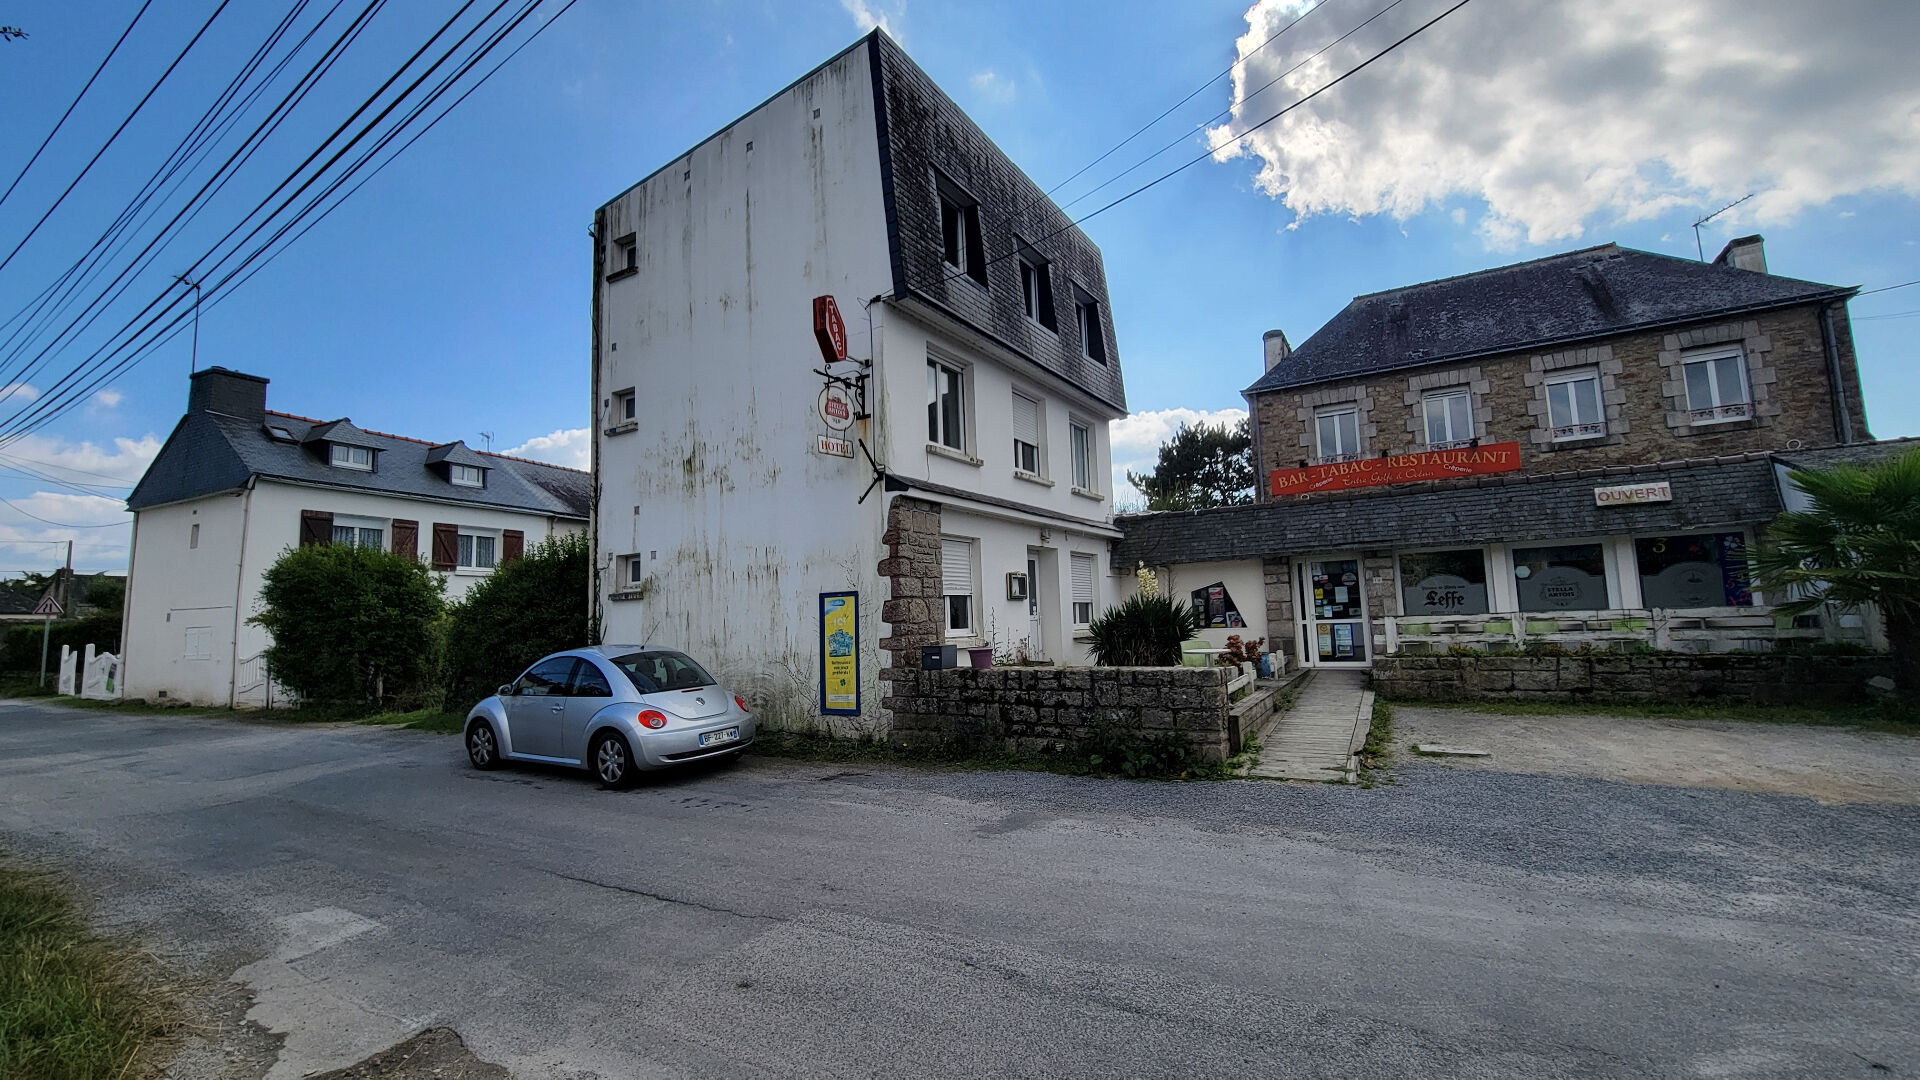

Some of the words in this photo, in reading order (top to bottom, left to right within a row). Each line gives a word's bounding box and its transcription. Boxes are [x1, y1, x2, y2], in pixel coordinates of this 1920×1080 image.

[829, 305, 842, 351] TABAC
[1279, 472, 1309, 488] BAR
[1317, 459, 1373, 479] TABAC
[1387, 451, 1511, 468] RESTAURANT
[1443, 463, 1472, 473] Crêperie
[1597, 487, 1669, 502] OUVERT
[1424, 590, 1465, 608] Leffe
